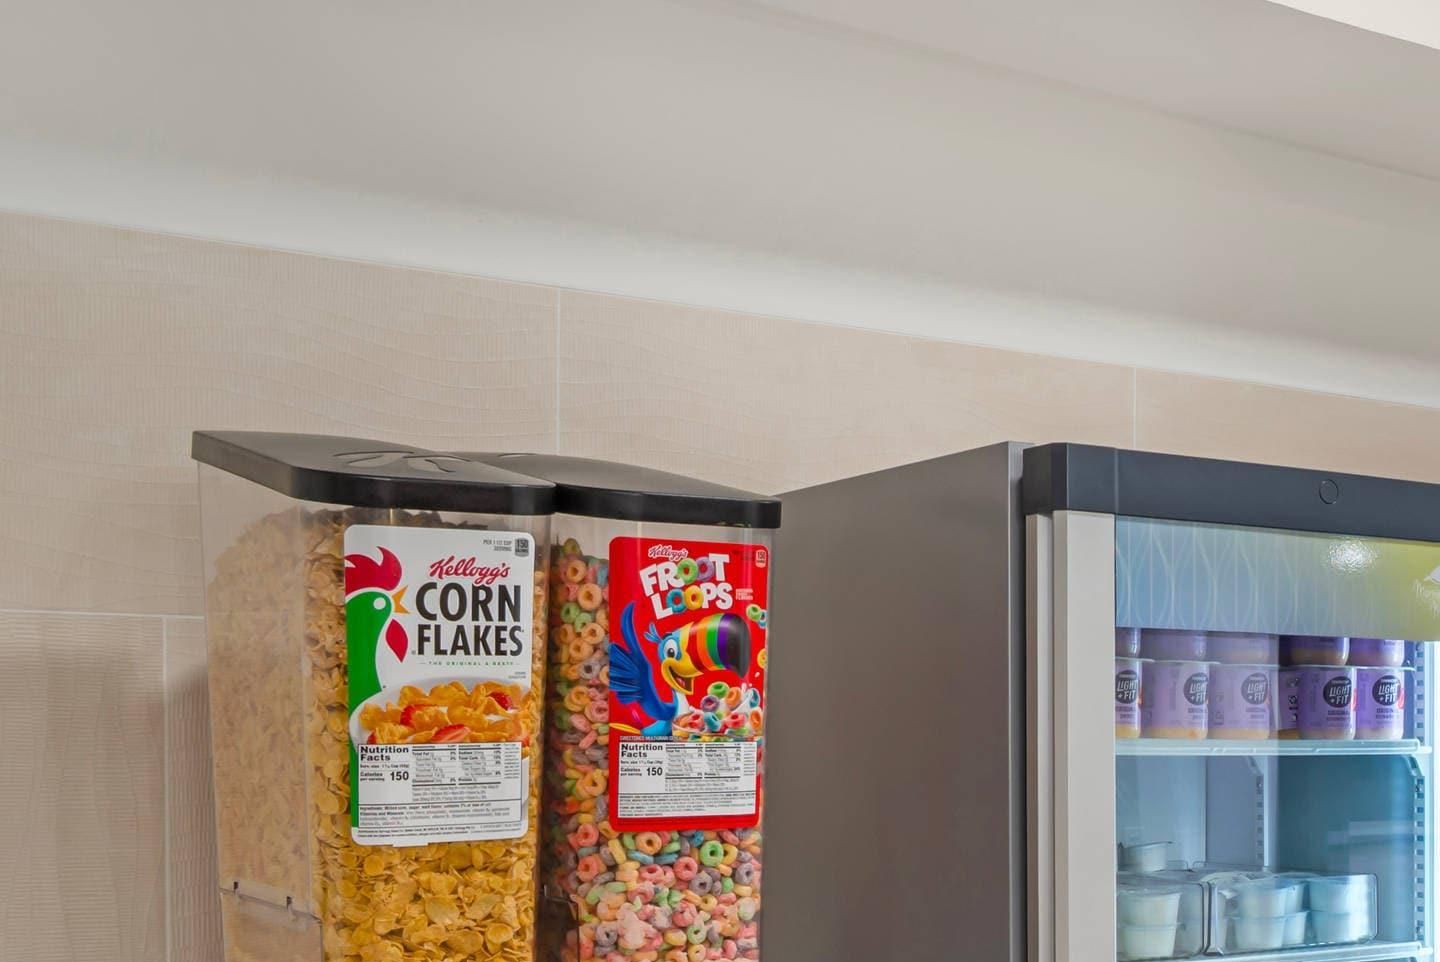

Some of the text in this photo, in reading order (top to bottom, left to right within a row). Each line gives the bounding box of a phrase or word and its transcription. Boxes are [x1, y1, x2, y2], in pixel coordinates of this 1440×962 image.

[648, 544, 688, 562] Kellogg's
[430, 556, 510, 584] Kellogg's
[639, 553, 730, 597] FROOT
[416, 582, 521, 622] CORN
[651, 582, 734, 620] LOOPS
[417, 624, 524, 656] FLAKES
[1330, 685, 1351, 696] LIGHT
[1378, 683, 1400, 695] LIGHT
[1124, 690, 1136, 700] FIT
[1255, 692, 1265, 701] FIT
[1336, 695, 1348, 704] FIT
[1385, 694, 1395, 702] FIT
[390, 771, 409, 781] 150
[646, 767, 662, 776] 150
